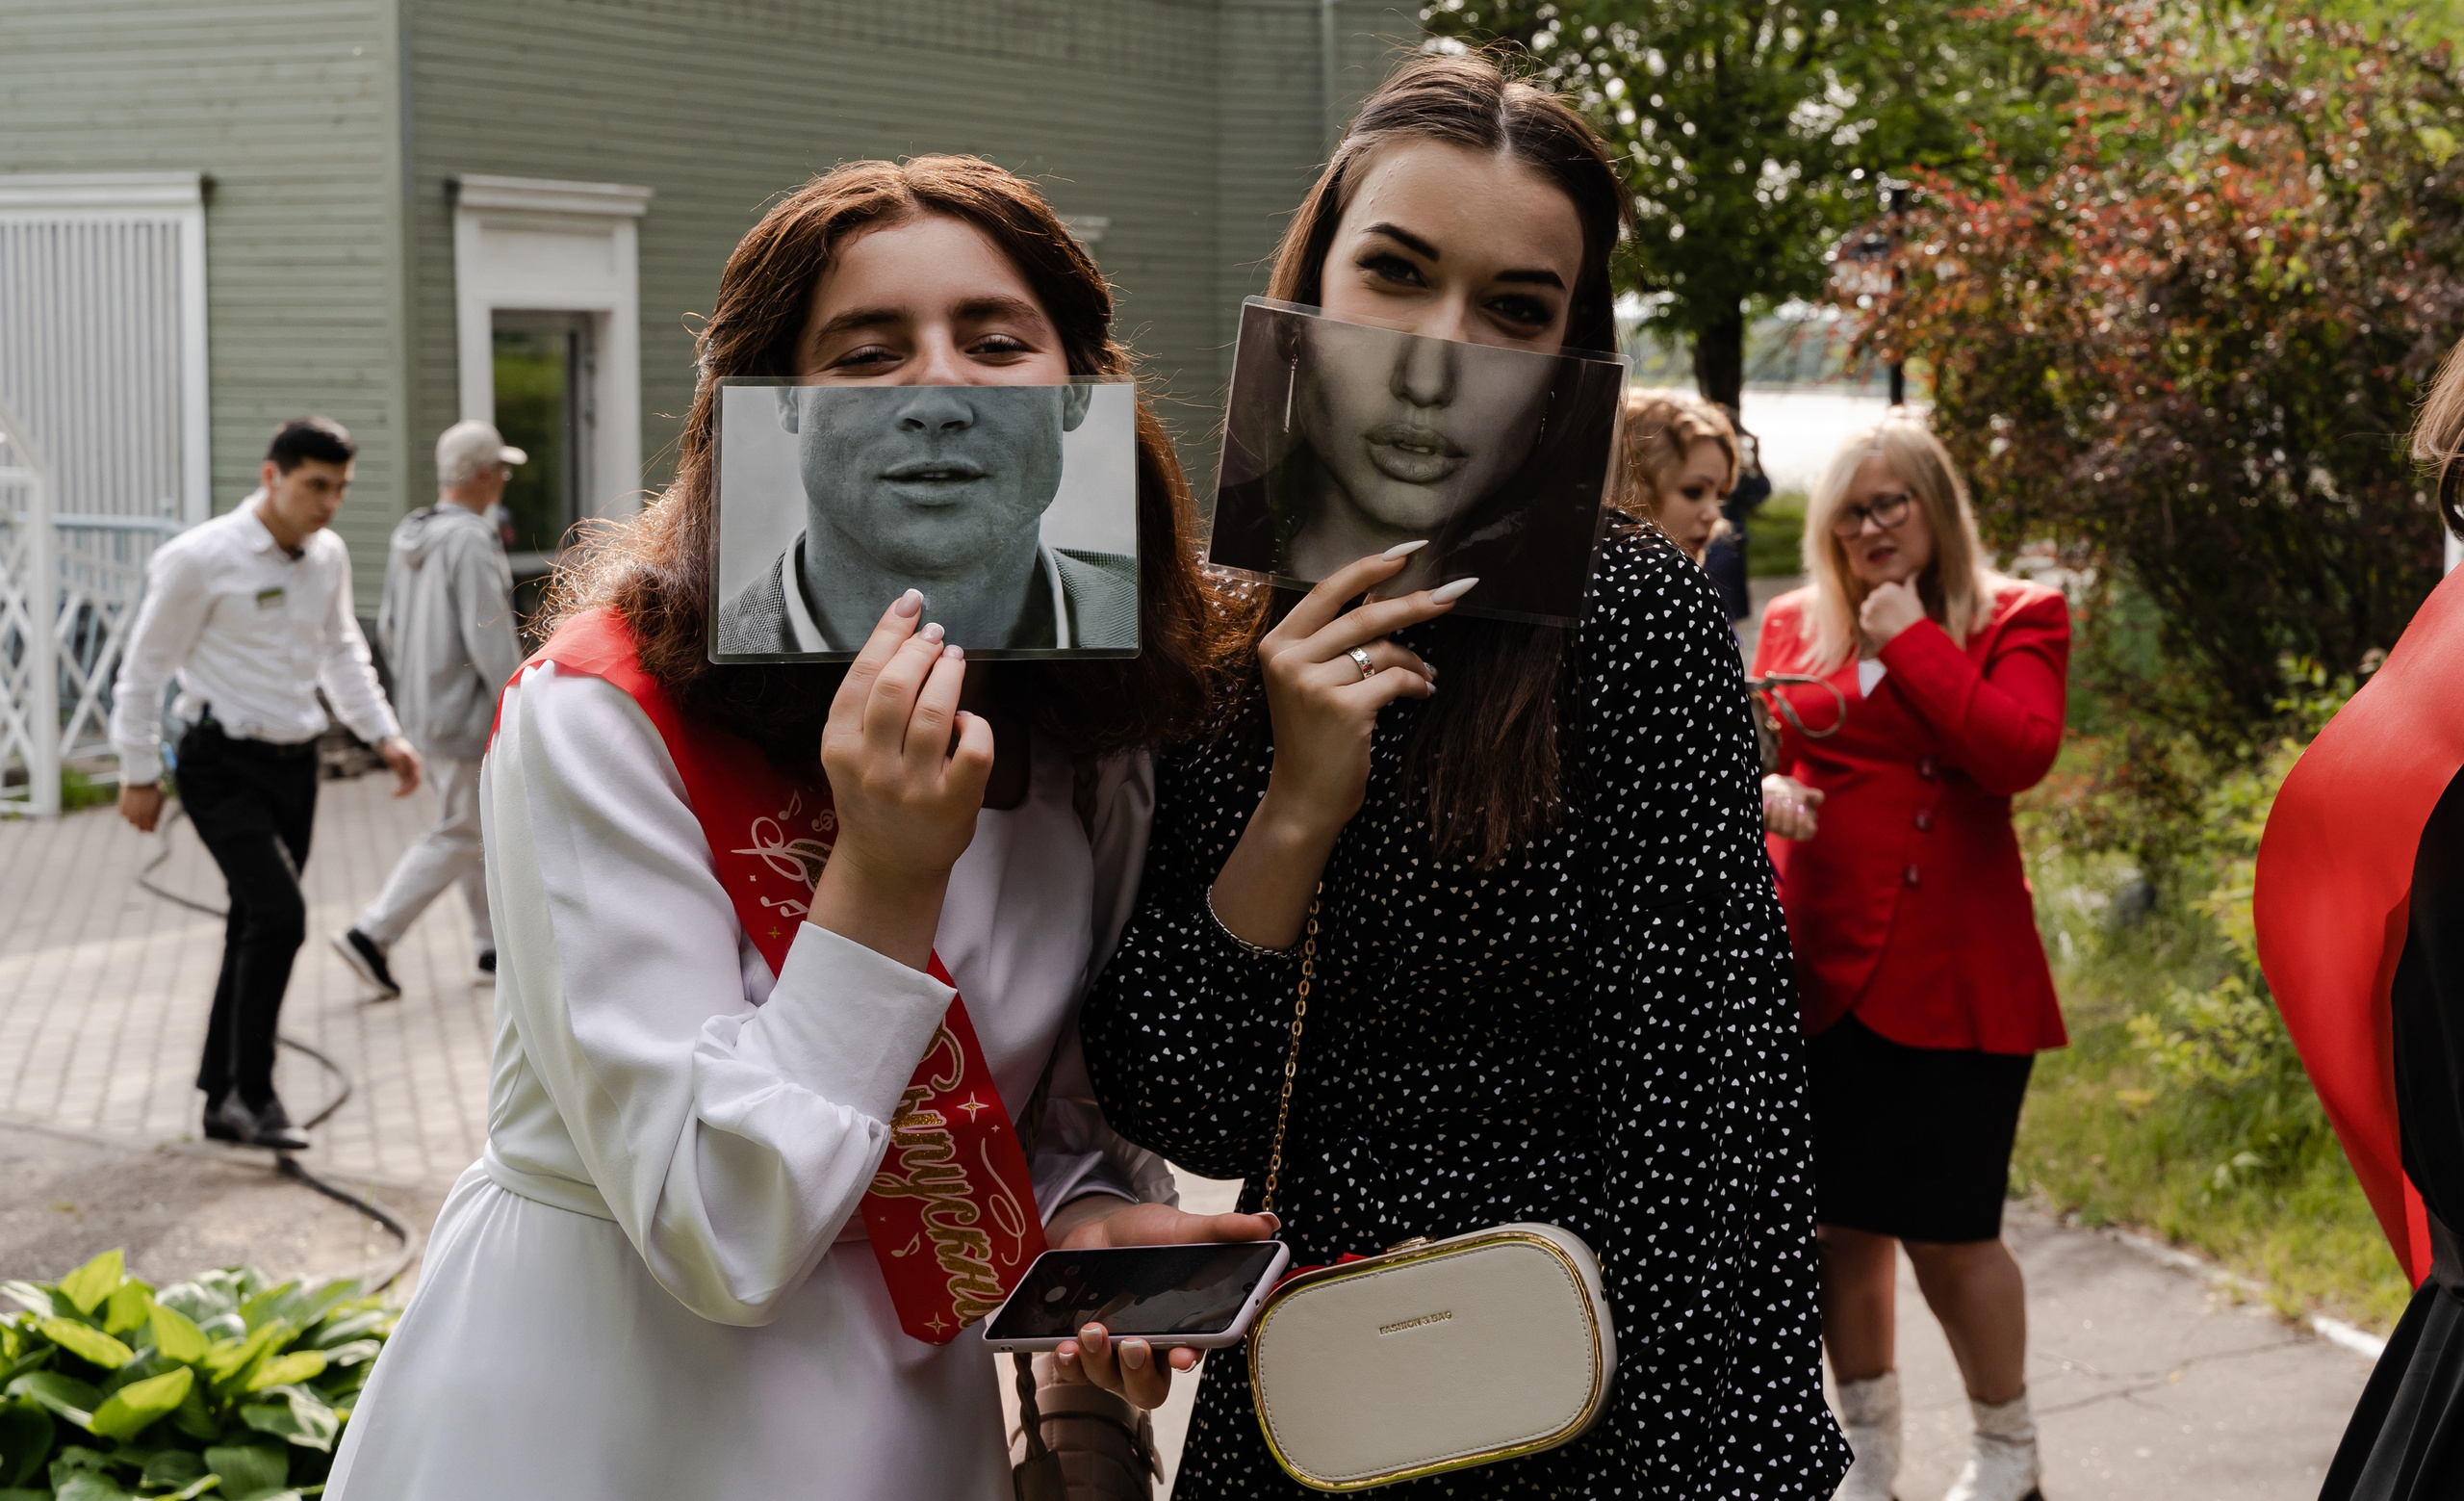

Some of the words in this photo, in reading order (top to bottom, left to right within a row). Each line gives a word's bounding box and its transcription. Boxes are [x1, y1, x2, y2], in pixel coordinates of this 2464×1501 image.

[1379, 1317, 1422, 1335] FASHION
[1422, 1315, 1430, 1325] &
[1430, 1310, 1452, 1323] BAG
